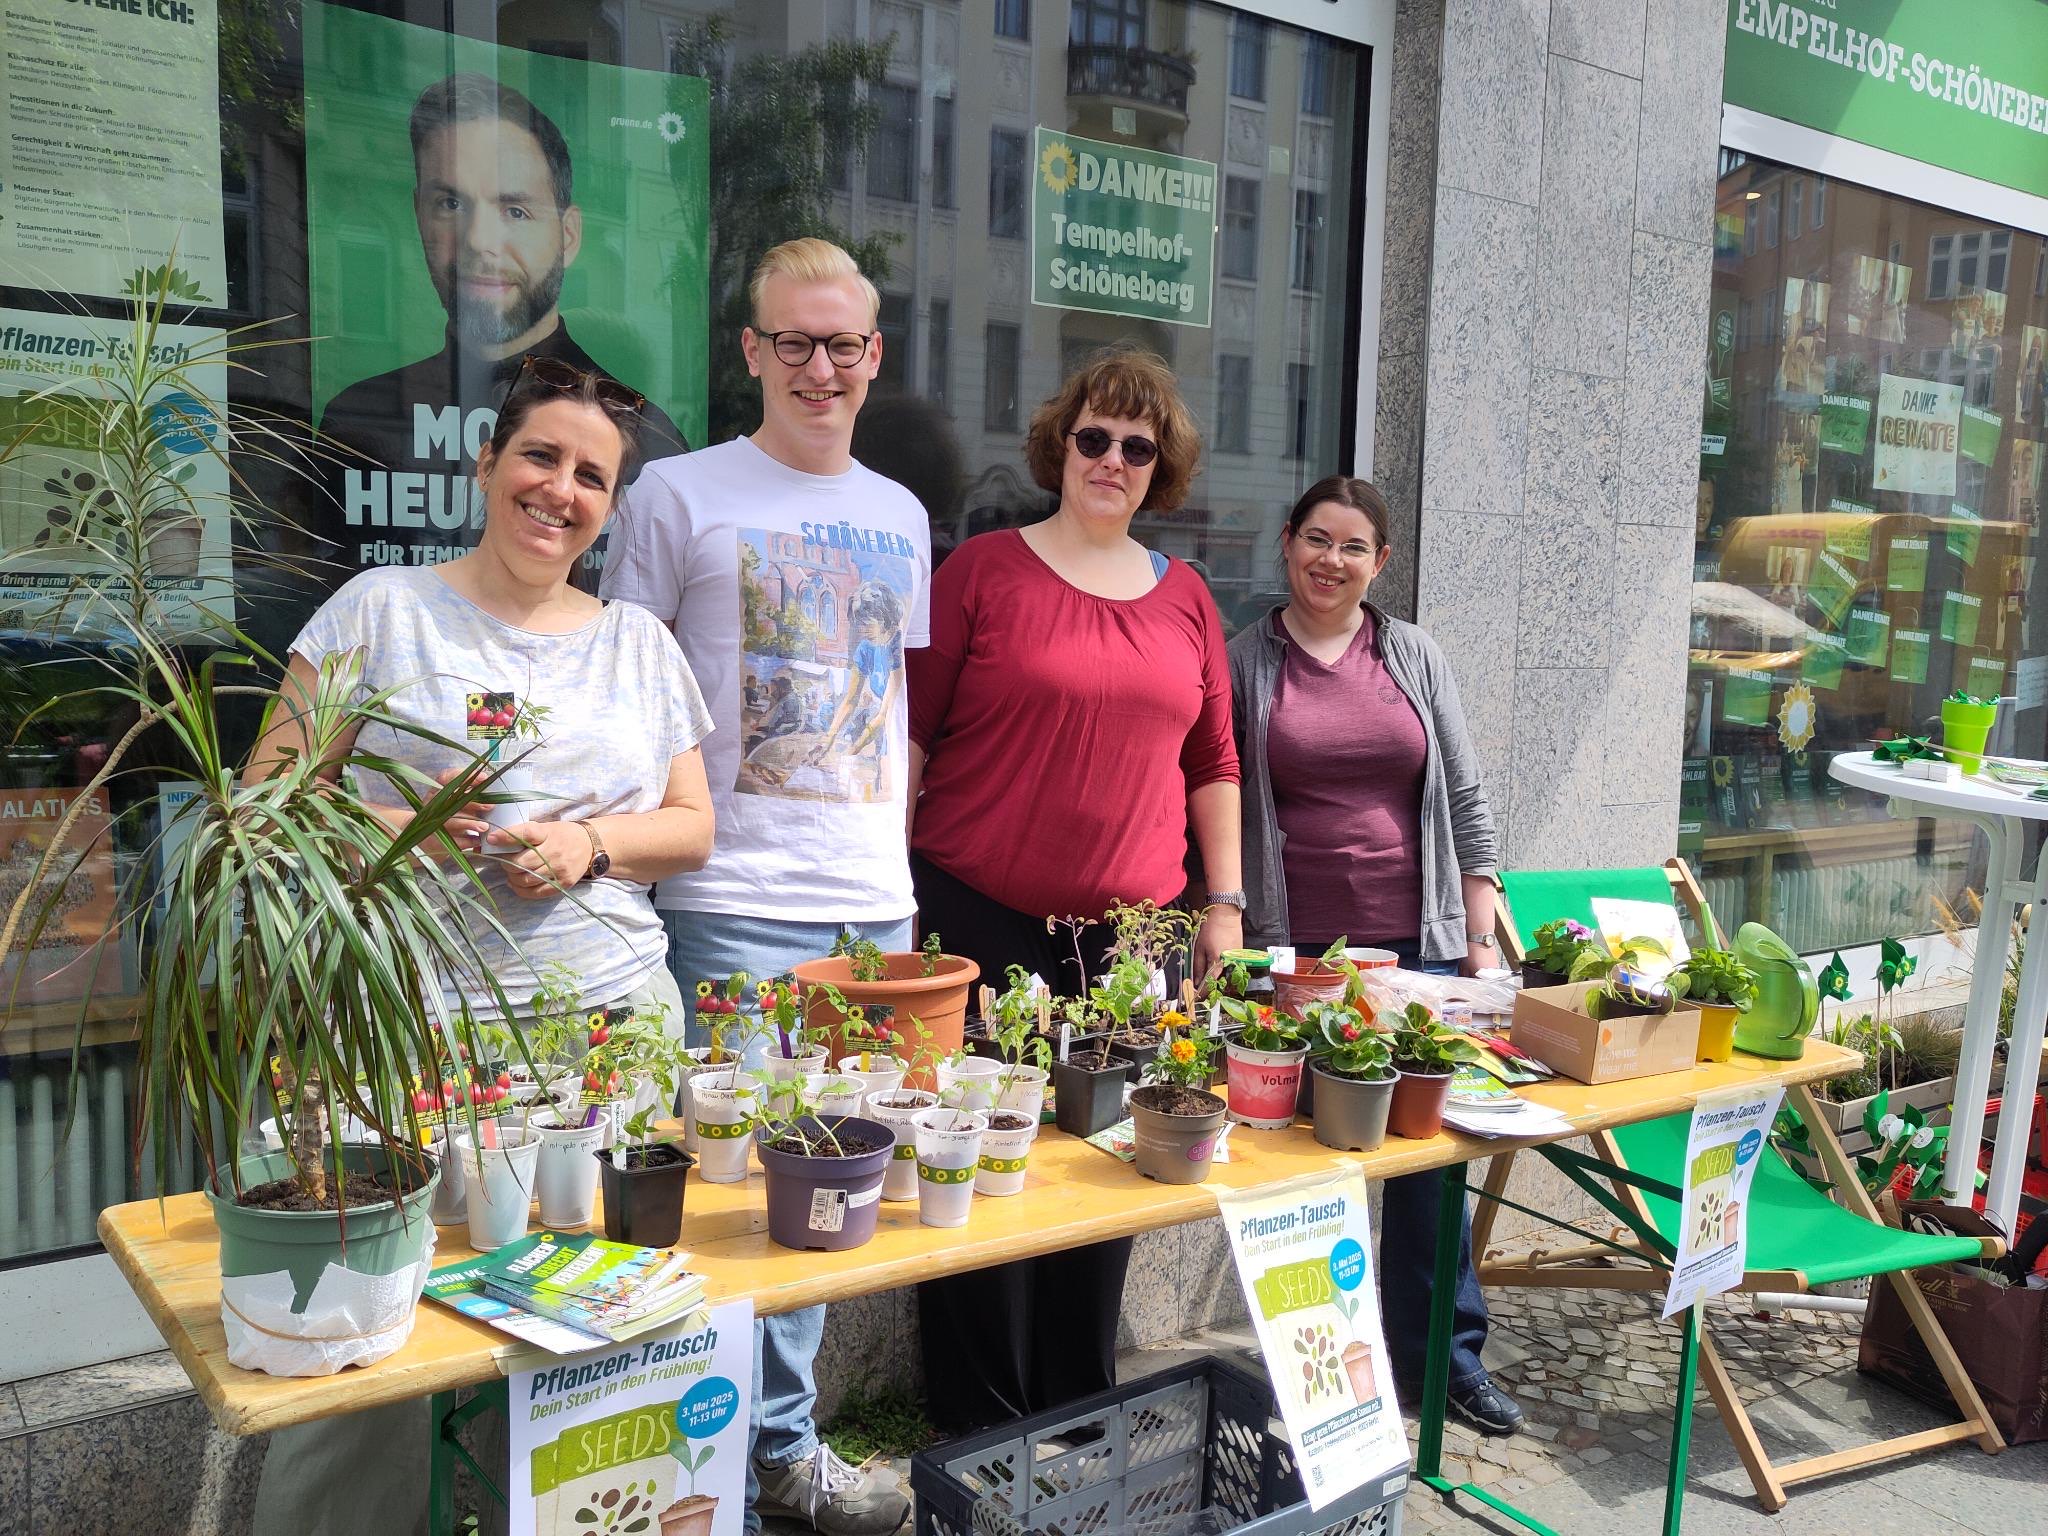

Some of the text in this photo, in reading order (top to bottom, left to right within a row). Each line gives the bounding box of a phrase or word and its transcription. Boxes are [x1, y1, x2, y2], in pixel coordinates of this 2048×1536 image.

[145, 0, 195, 25] ICH:
[54, 20, 98, 34] Wohnraum:
[57, 60, 68, 68] für
[1735, 0, 2048, 136] EMPELHOF-SCHÖNEBE
[10, 93, 60, 107] Investitionen
[610, 117, 654, 129] gruene.de
[12, 133, 62, 147] Gerechtigkeit
[74, 142, 111, 155] Wirtschaft
[113, 149, 129, 158] geht
[14, 184, 75, 197] Moderner Staat:
[1079, 152, 1212, 212] DANKE!!!
[16, 222, 104, 240] Zusammenhalt stärken:
[1052, 213, 1193, 263] Tempelhof-
[1050, 258, 1195, 313] Schöneberg
[0, 355, 21, 372] ein
[1823, 395, 1871, 412] DANKE RENATE
[1902, 389, 1939, 415] DANKE
[1880, 415, 1956, 453] RENATE
[360, 540, 405, 566] FÜR
[801, 521, 915, 560] SCHÖNEBERG
[2, 574, 36, 589] Bringt
[37, 576, 67, 589] gerne
[1695, 1100, 1766, 1131] Pflanzen-Tausch
[1703, 1146, 1736, 1180] SEEDS
[1240, 1197, 1346, 1242] Pflanzen-Tausch
[1261, 1237, 1282, 1253] Start
[1283, 1234, 1291, 1247] in
[1292, 1230, 1307, 1243] den
[1308, 1220, 1345, 1241] Frühling!
[425, 1268, 466, 1288] GRÜN
[1332, 1262, 1339, 1272] 3.
[1278, 1264, 1332, 1309] SEEDS
[530, 1327, 718, 1401] Pflanzen-Tausch
[530, 1355, 713, 1421] Dein Start in den Frühling!
[681, 1391, 734, 1417] 3. Mai 2025
[689, 1405, 727, 1428] 11-13 Uhr
[576, 1409, 672, 1473] SEEDS
